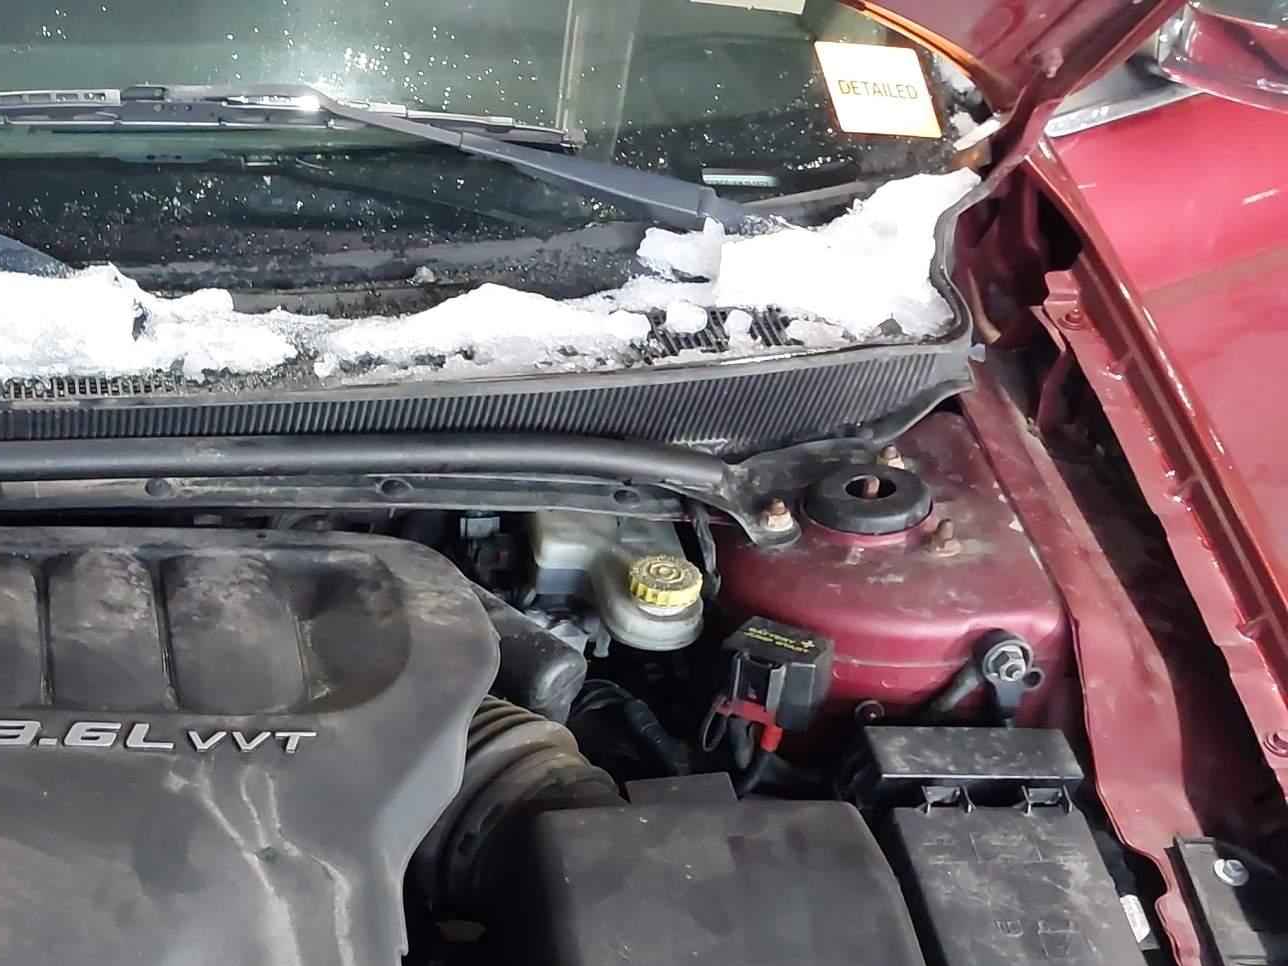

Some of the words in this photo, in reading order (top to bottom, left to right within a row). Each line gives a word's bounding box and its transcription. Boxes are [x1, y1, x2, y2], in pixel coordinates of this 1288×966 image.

[838, 79, 918, 100] DETAILED
[748, 627, 796, 644] BATTERY
[775, 641, 809, 653] START
[187, 730, 317, 754] VVT
